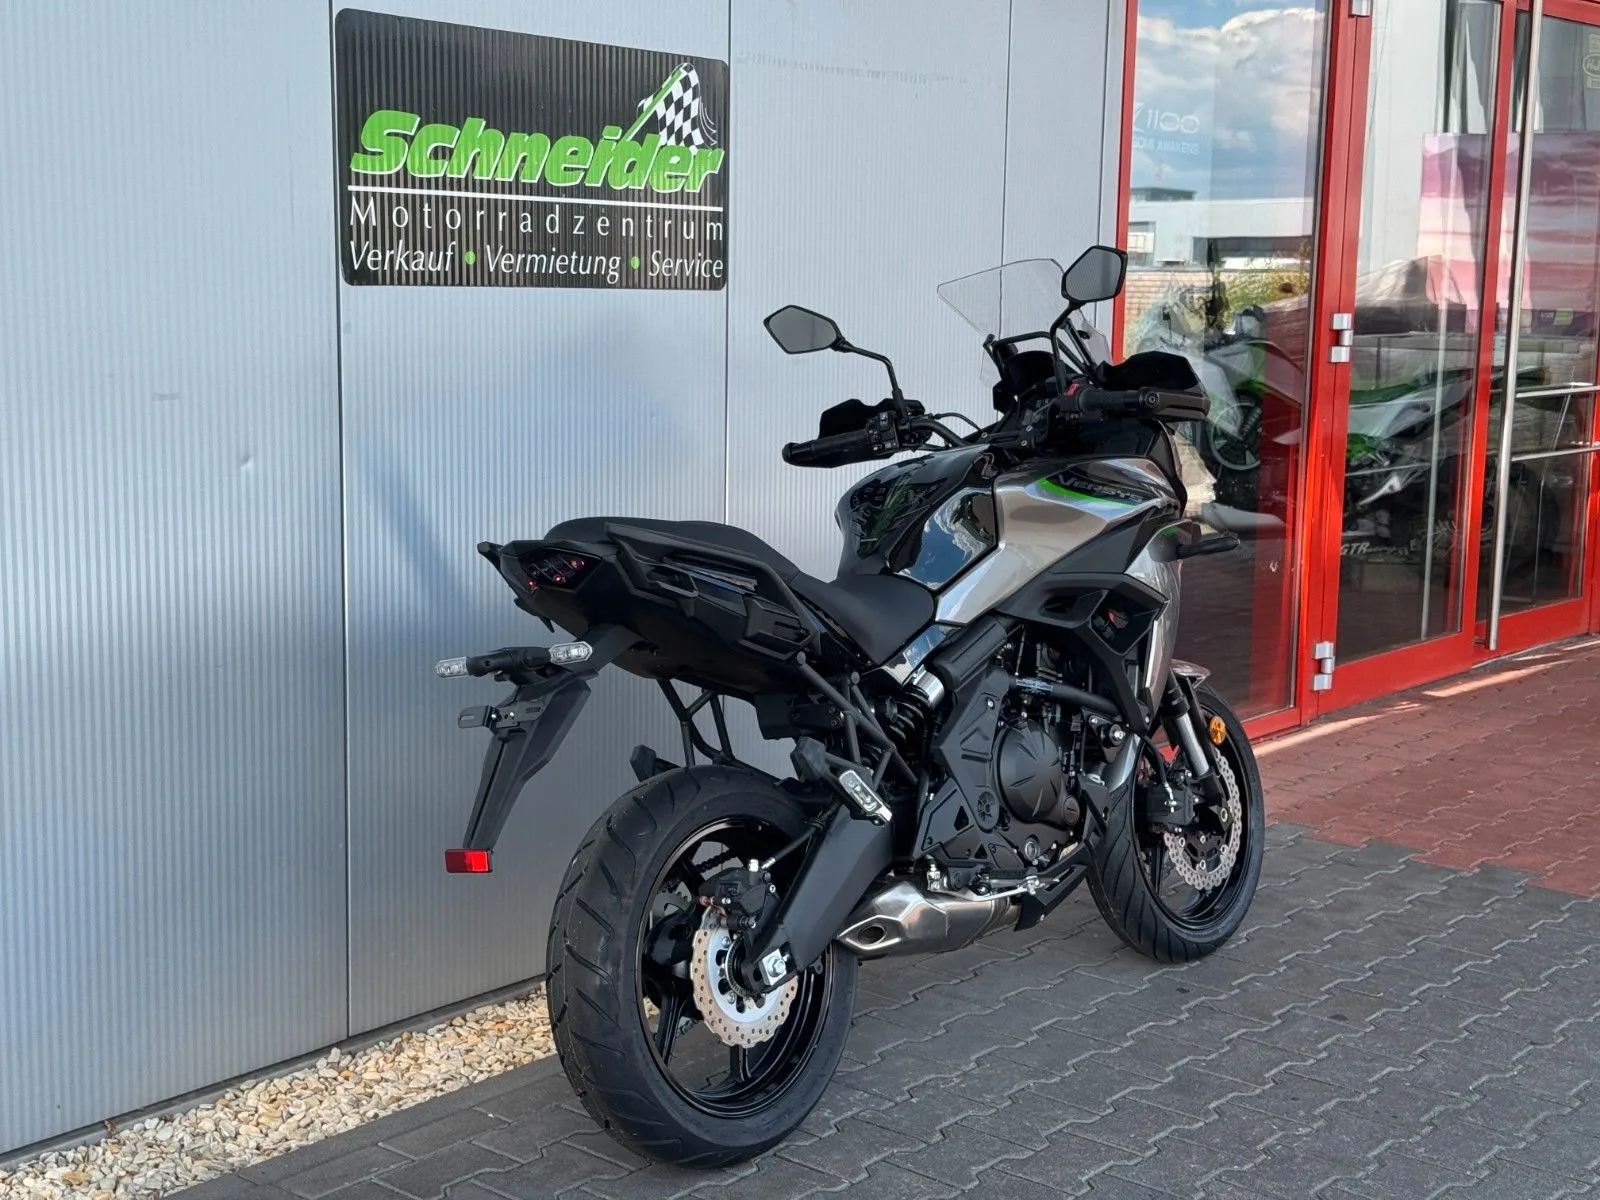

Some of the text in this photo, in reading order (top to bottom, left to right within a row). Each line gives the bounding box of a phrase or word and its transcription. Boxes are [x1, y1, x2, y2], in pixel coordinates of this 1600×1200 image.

[350, 109, 724, 193] Schneider
[350, 196, 723, 240] Motorradzentrum
[350, 240, 723, 284] Verkauf Vermietung Service
[1058, 473, 1145, 503] VERSYS
